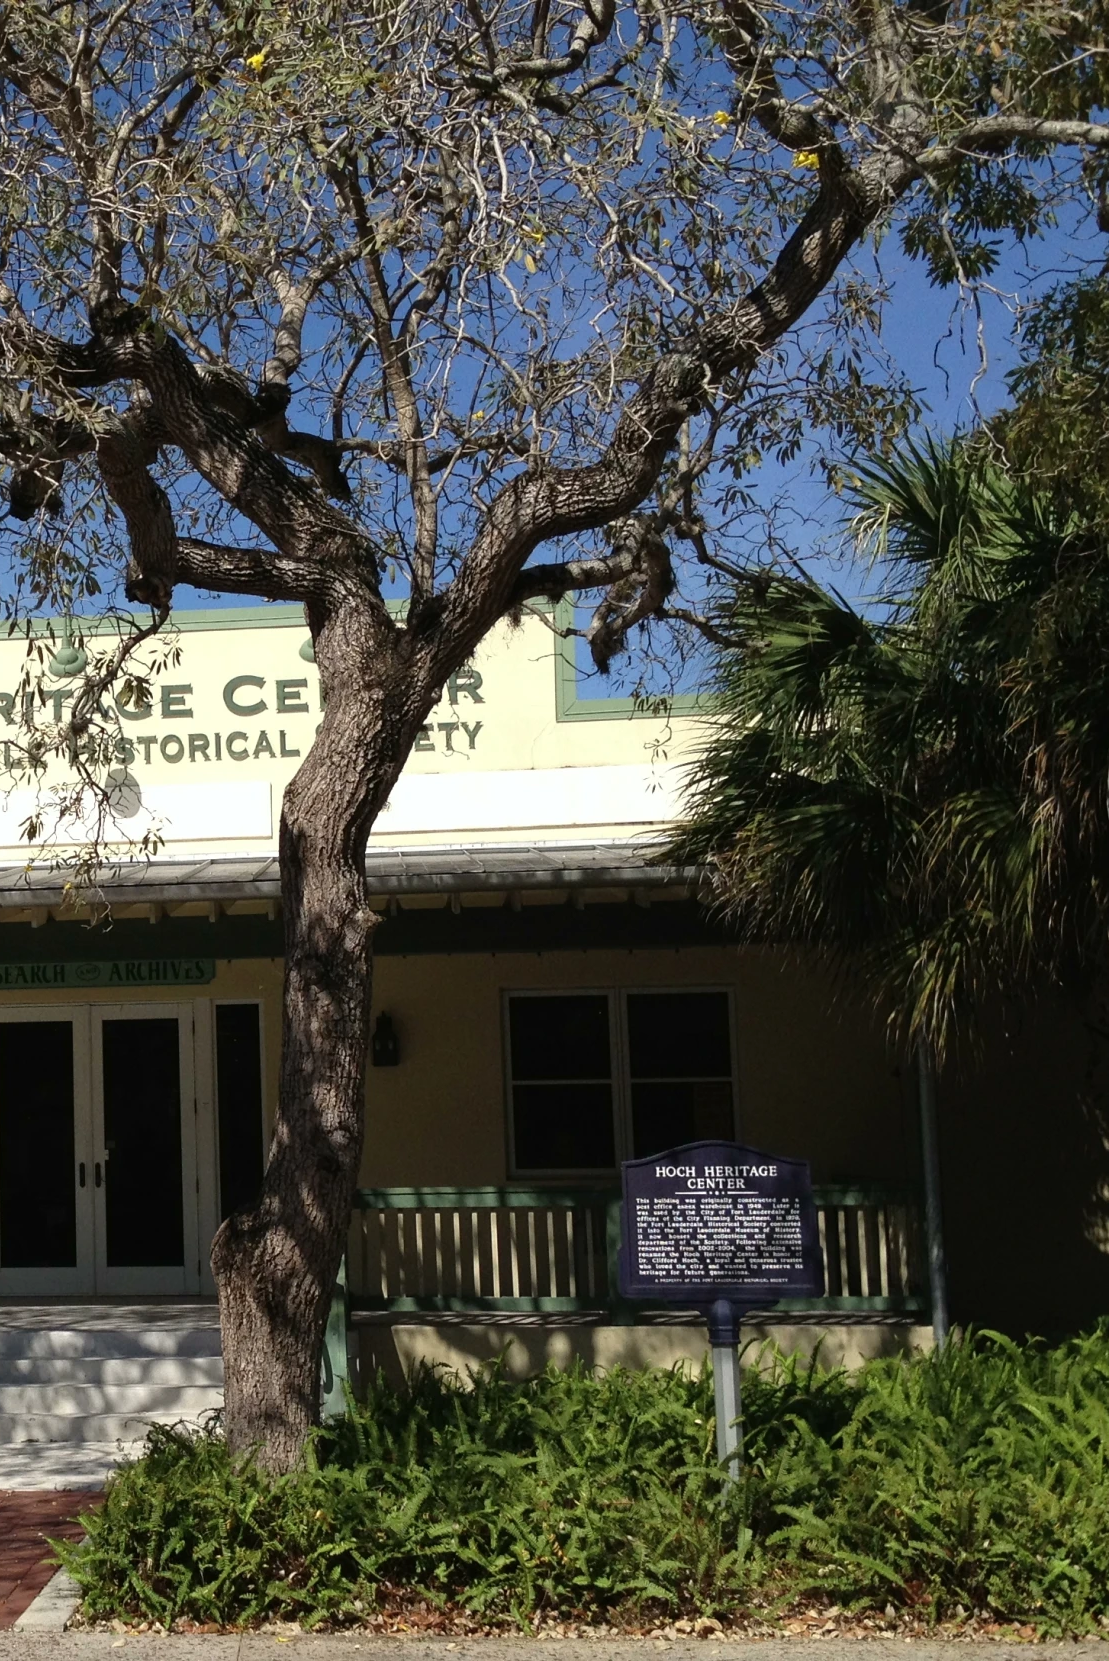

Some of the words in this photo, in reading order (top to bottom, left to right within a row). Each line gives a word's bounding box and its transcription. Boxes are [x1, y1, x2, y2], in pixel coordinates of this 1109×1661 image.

[223, 670, 486, 717] CER
[109, 960, 205, 981] ARCHIVES
[655, 1166, 696, 1177] HOCH
[704, 1166, 777, 1177] HERITAGE
[687, 1178, 745, 1189] CENTER
